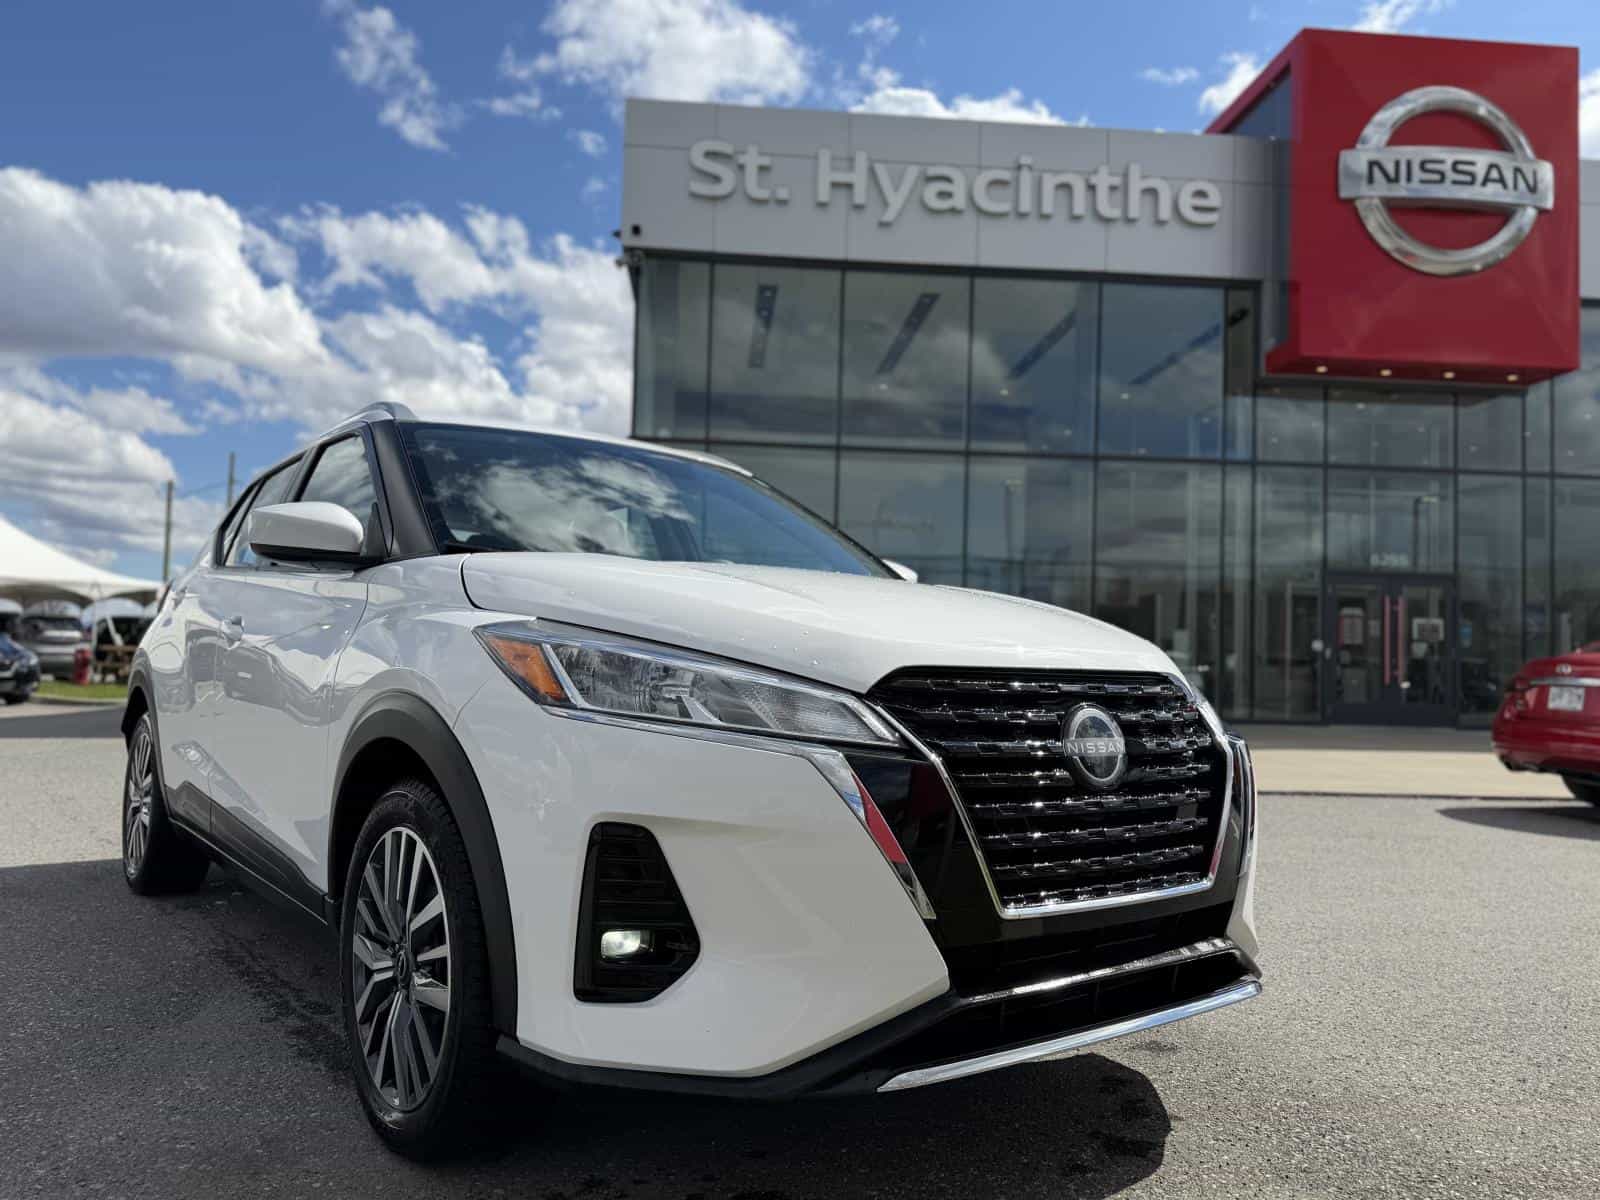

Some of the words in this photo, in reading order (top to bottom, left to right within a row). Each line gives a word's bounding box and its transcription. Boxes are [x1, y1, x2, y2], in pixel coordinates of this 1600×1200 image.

[688, 139, 790, 202] St.
[814, 147, 1223, 226] Hyacinthe
[1366, 159, 1539, 195] NISSAN
[1066, 742, 1125, 754] NISSAN
